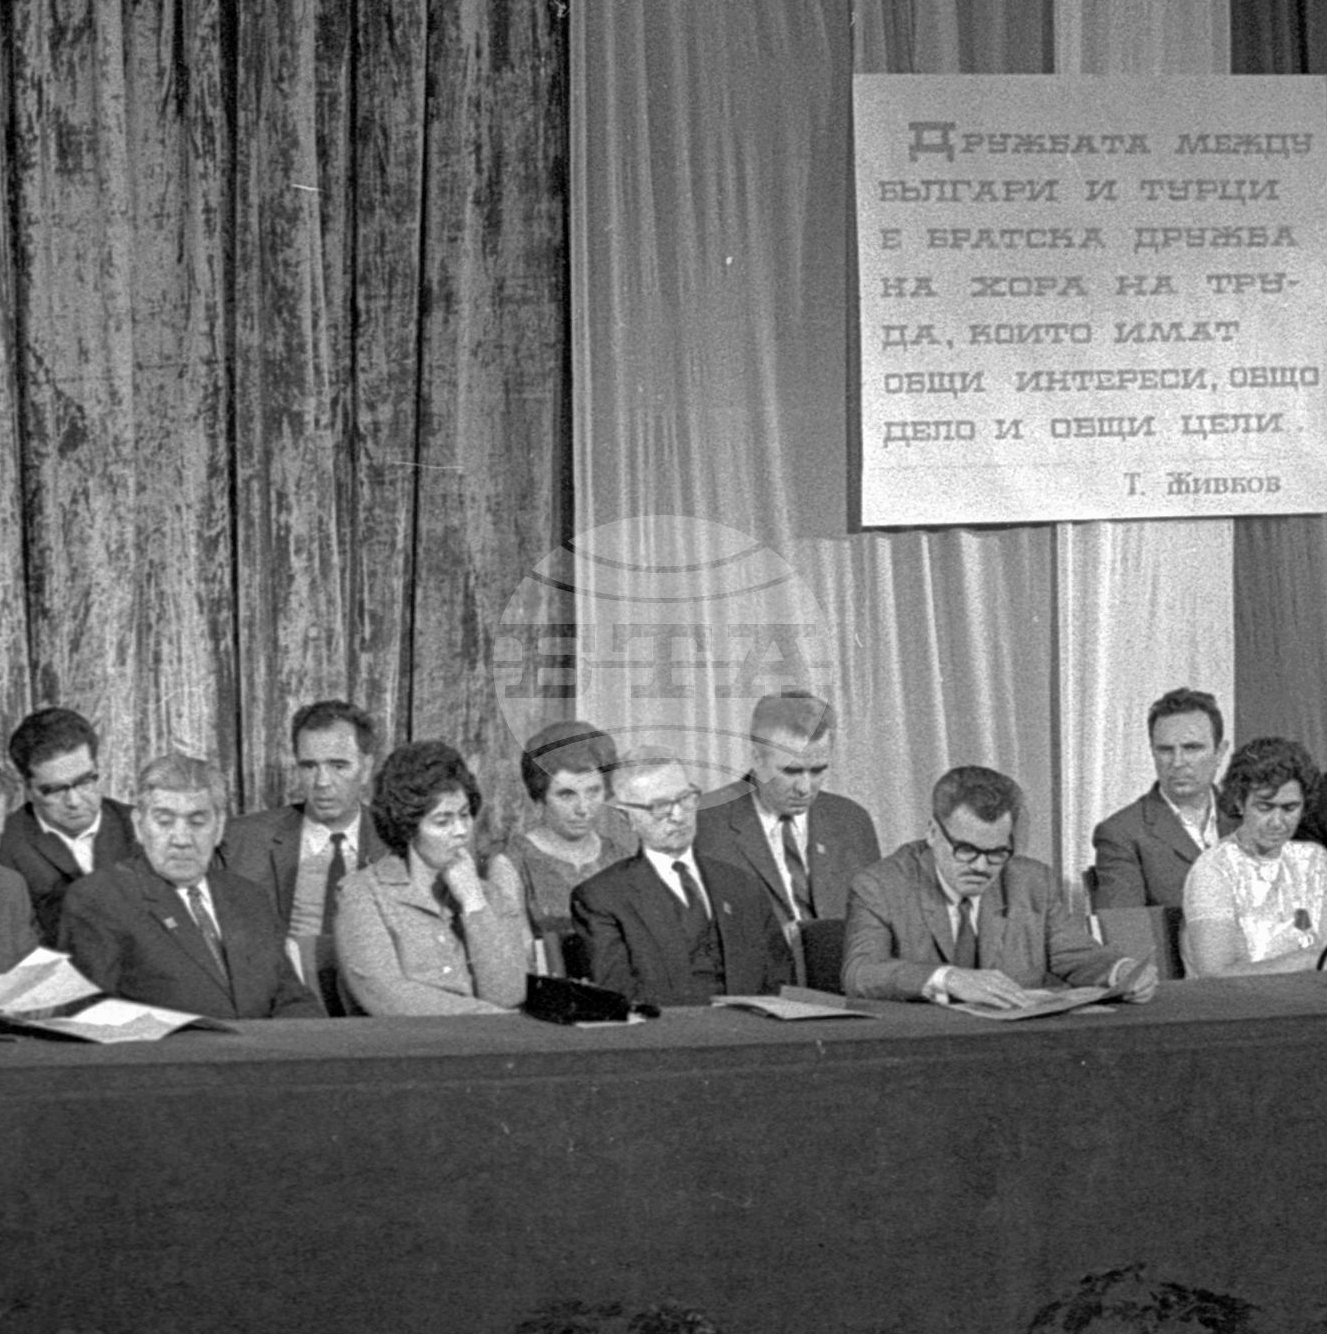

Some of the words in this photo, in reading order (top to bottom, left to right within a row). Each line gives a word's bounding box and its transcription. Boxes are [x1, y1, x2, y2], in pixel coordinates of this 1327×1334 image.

[1174, 133, 1313, 159] МЕЖДУ
[878, 179, 1059, 202] БЪЛГАРИ
[1085, 178, 1117, 201] И
[1140, 179, 1279, 206] ТУРЦИ
[880, 228, 902, 249] Е
[927, 227, 1105, 250] БРАТСКА
[1134, 226, 1298, 254] ДРУЖБА
[880, 277, 937, 298] НА
[972, 276, 1088, 298] ХОРА
[1115, 275, 1179, 296] НА
[1206, 272, 1300, 295] ТРУ-
[882, 323, 954, 352] ДА,
[969, 322, 1093, 345] КОИТО
[1114, 321, 1240, 344] ИМАТ
[884, 371, 986, 399] ОБЩИ
[1016, 367, 1218, 394] ИНТЕРЕСИ,
[1229, 366, 1320, 392] ОБЩО
[994, 418, 1024, 440] И
[1050, 416, 1156, 441] ОБЩИ
[1123, 471, 1146, 496] Т.
